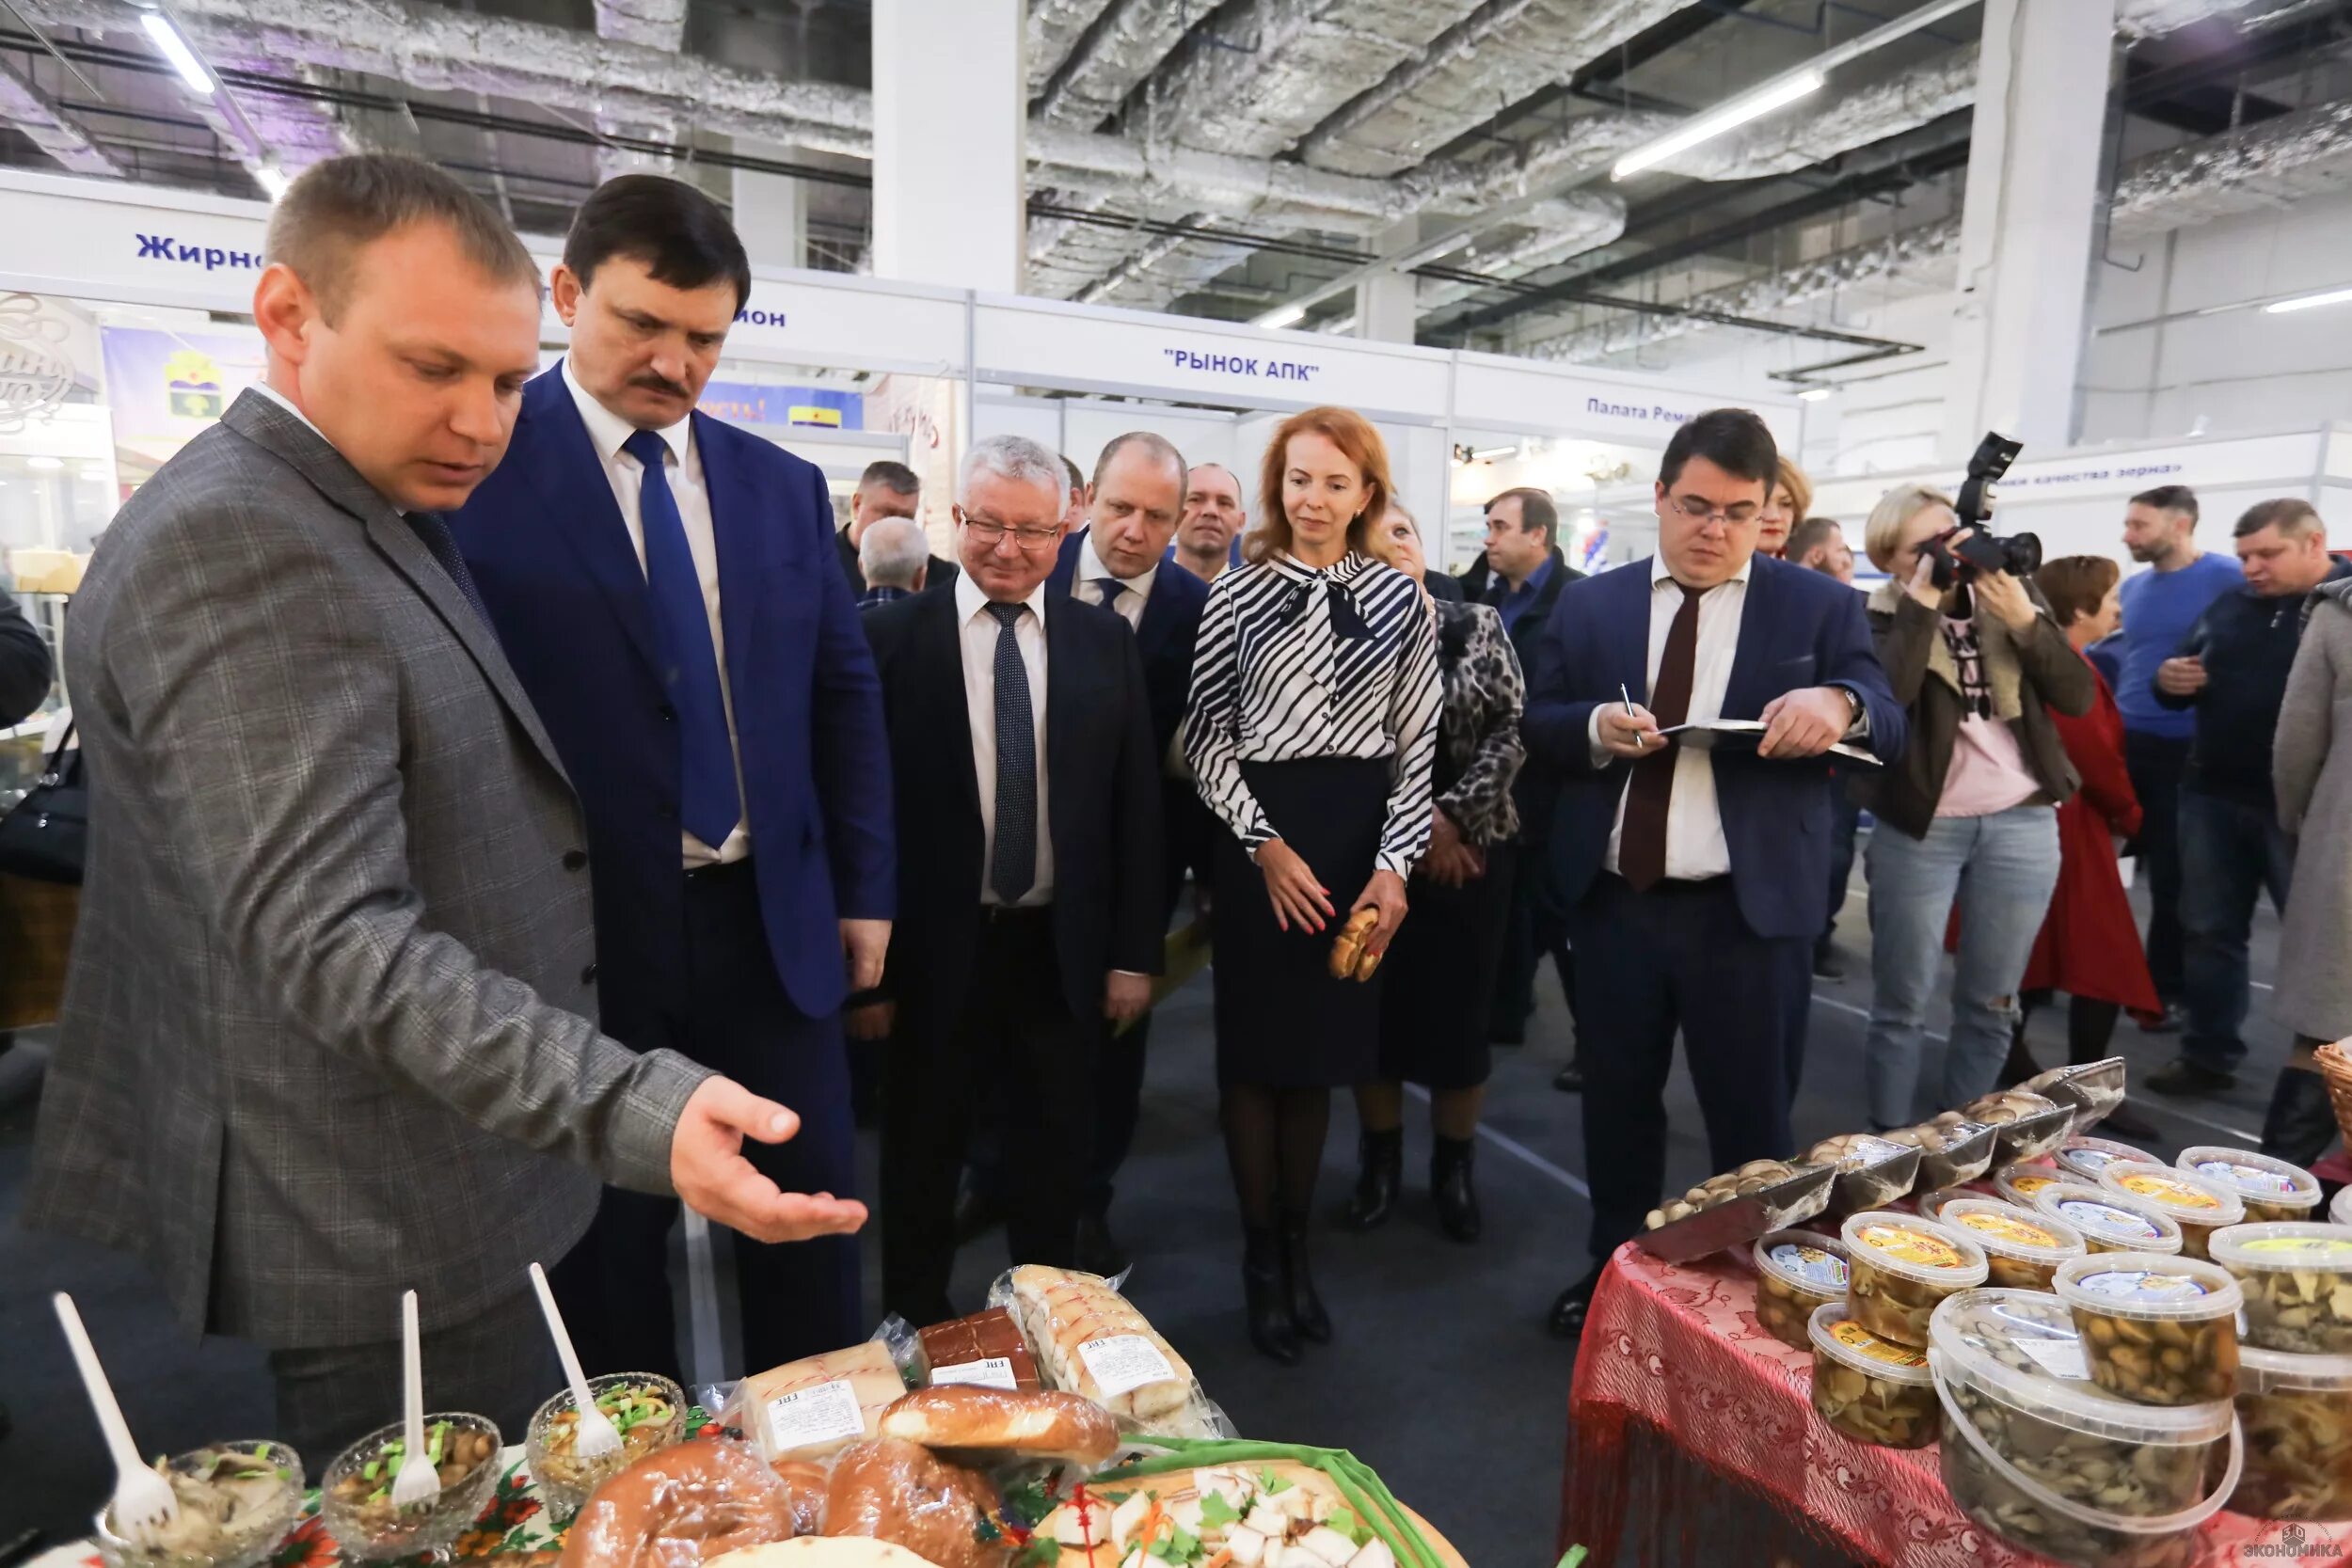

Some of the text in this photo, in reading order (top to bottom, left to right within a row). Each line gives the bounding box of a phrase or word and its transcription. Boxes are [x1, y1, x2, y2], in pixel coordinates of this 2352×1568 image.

[1164, 349, 1319, 381] "РЫНОК АПК"
[1587, 398, 1648, 420] Палата
